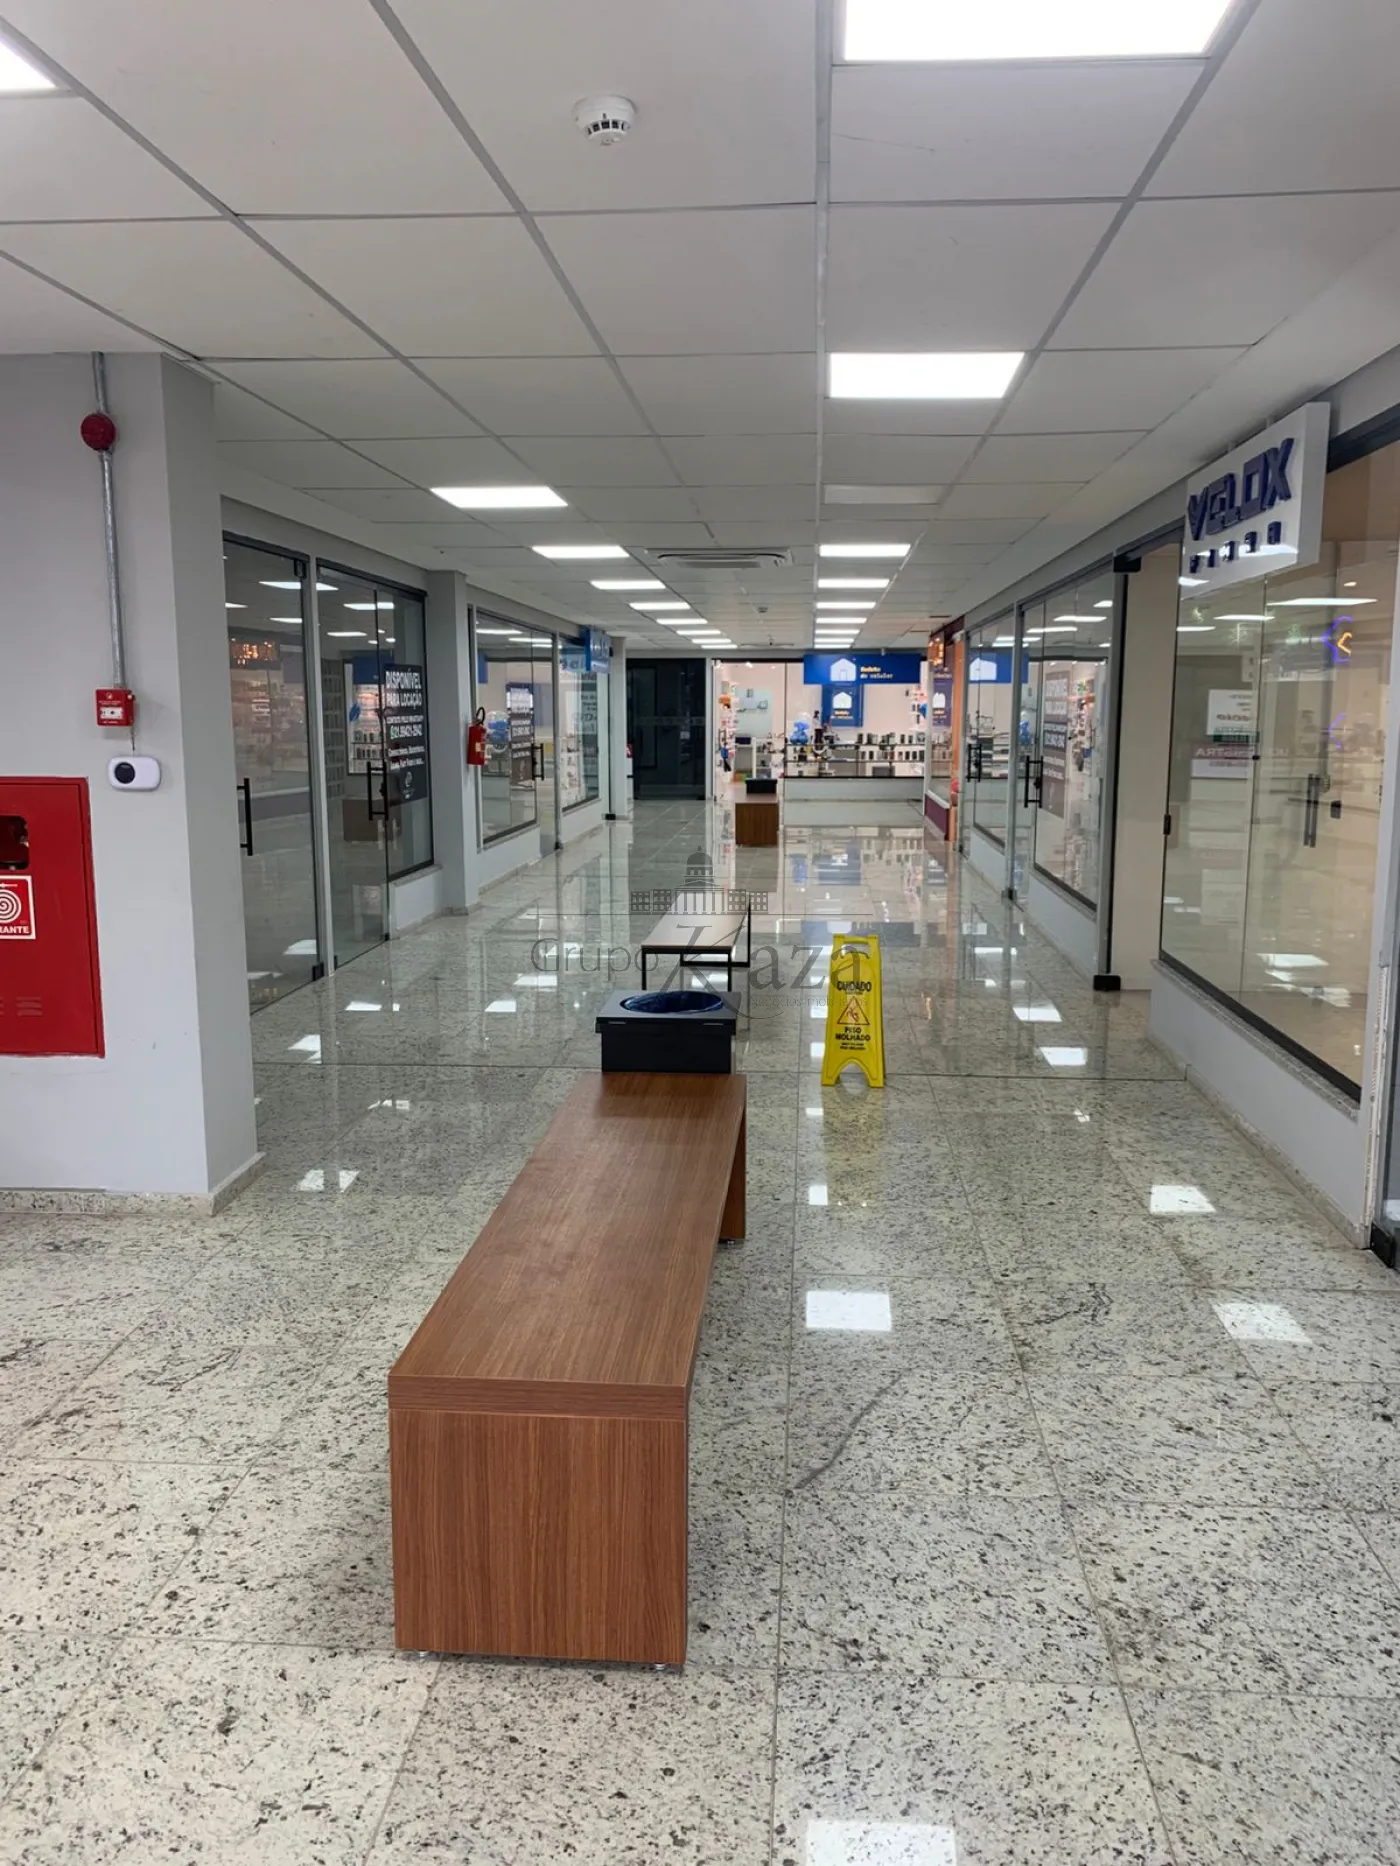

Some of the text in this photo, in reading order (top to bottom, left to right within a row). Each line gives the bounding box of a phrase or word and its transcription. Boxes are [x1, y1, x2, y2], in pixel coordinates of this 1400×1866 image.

[1187, 437, 1295, 541] VELOX
[385, 667, 422, 689] DISPONÍVEL
[837, 981, 872, 992] CUIDADO
[836, 1033, 871, 1042] MOLHADO
